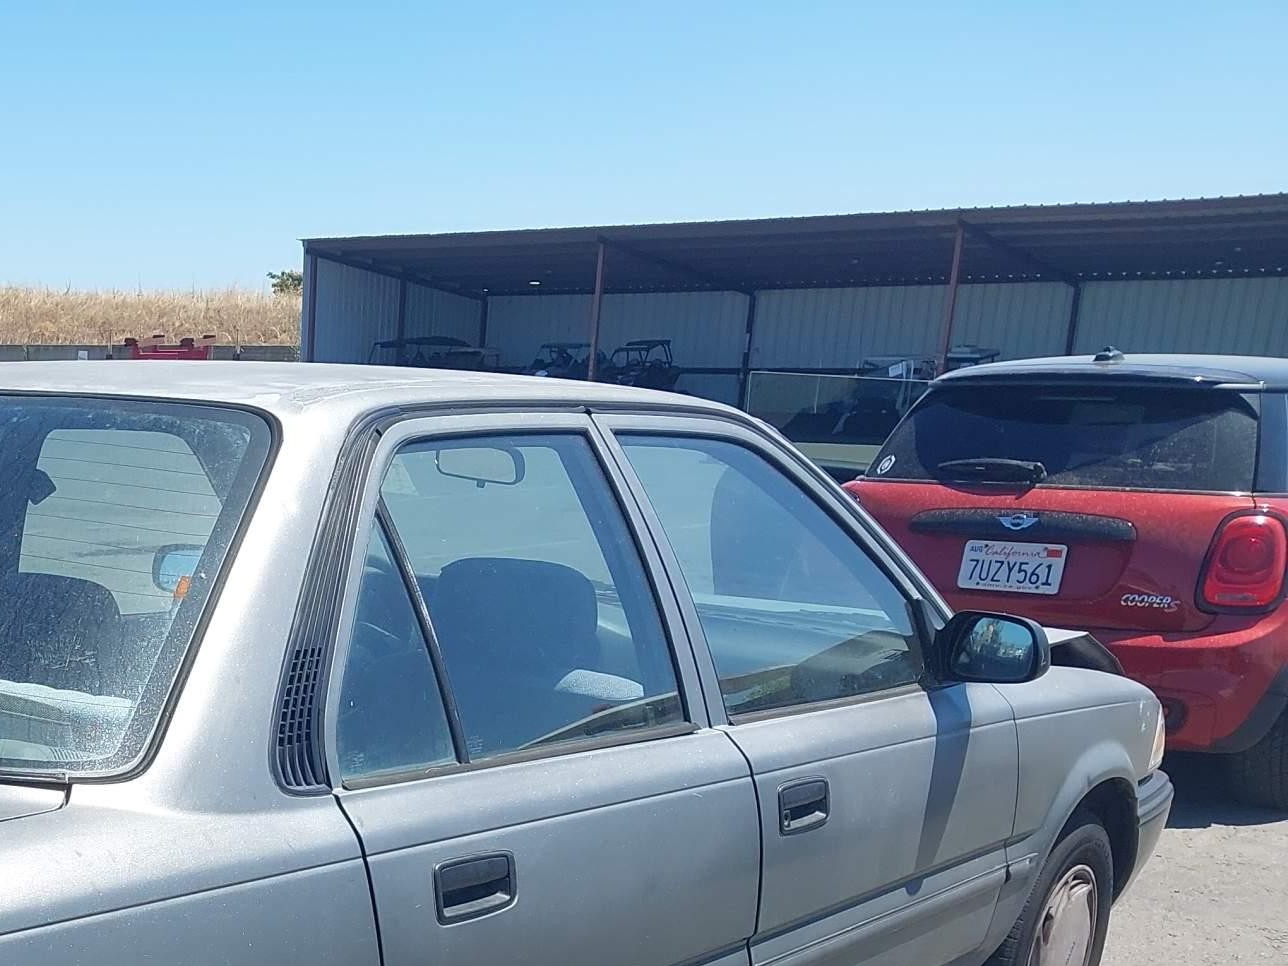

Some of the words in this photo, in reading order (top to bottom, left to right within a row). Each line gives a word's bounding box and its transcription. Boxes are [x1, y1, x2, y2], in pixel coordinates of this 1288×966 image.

[984, 544, 1047, 560] California
[968, 559, 1053, 586] 7UZY561
[1120, 593, 1172, 608] COOPER
[1164, 600, 1181, 612] S
